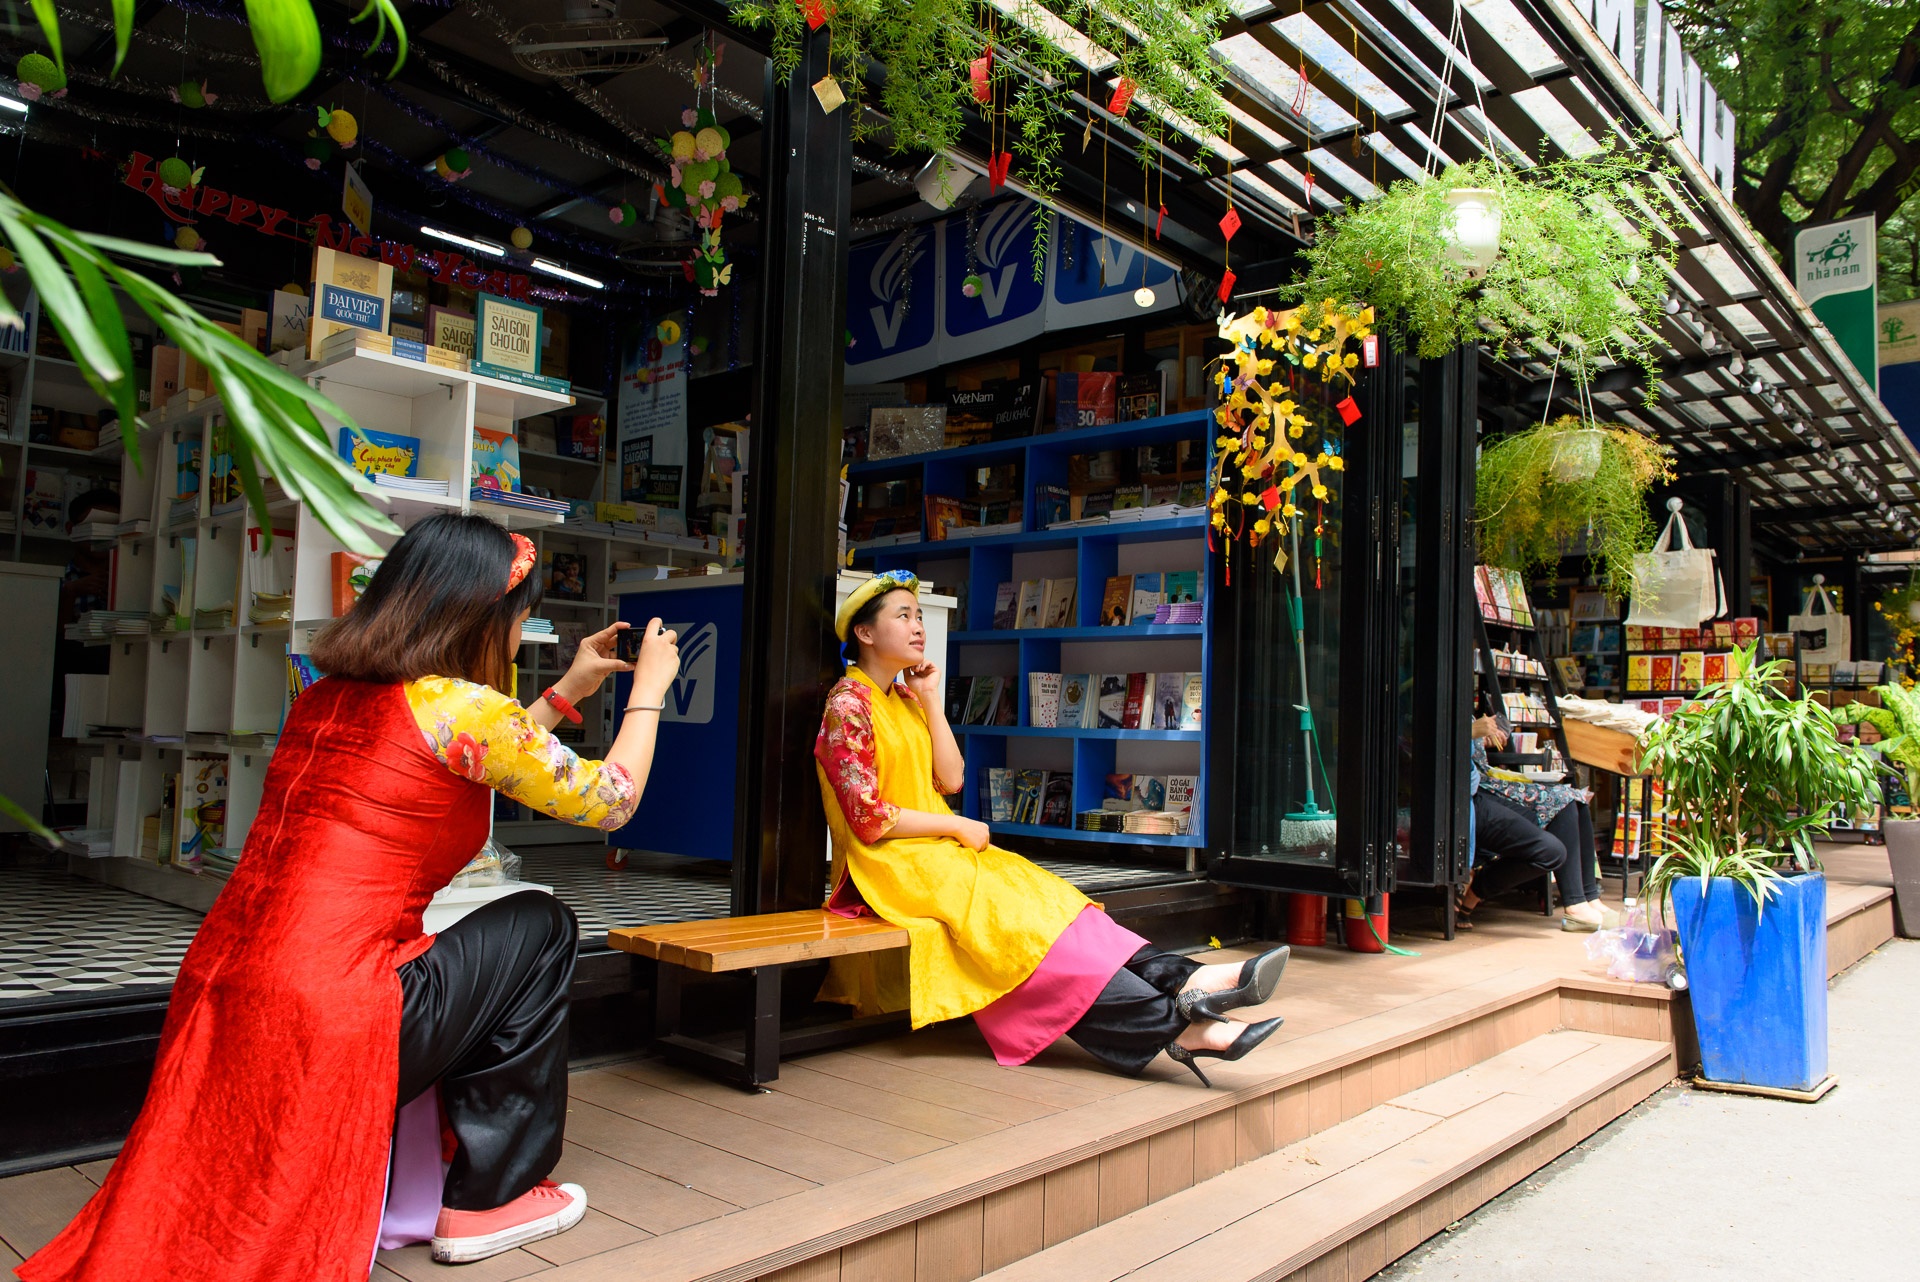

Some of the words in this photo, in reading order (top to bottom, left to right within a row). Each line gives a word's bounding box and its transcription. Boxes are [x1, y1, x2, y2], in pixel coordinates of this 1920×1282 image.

[1833, 263, 1861, 278] nam
[980, 262, 1019, 320] V
[351, 296, 379, 317] VIỆT
[442, 325, 458, 344] SÀI
[459, 329, 473, 347] GÒ
[492, 314, 509, 333] SÀI
[509, 319, 530, 339] GÒN
[869, 301, 903, 350] V
[490, 331, 511, 351] CHỢ
[511, 335, 530, 355] LỚN
[1077, 409, 1096, 427] 30
[571, 441, 583, 454] 30
[672, 678, 698, 717] V
